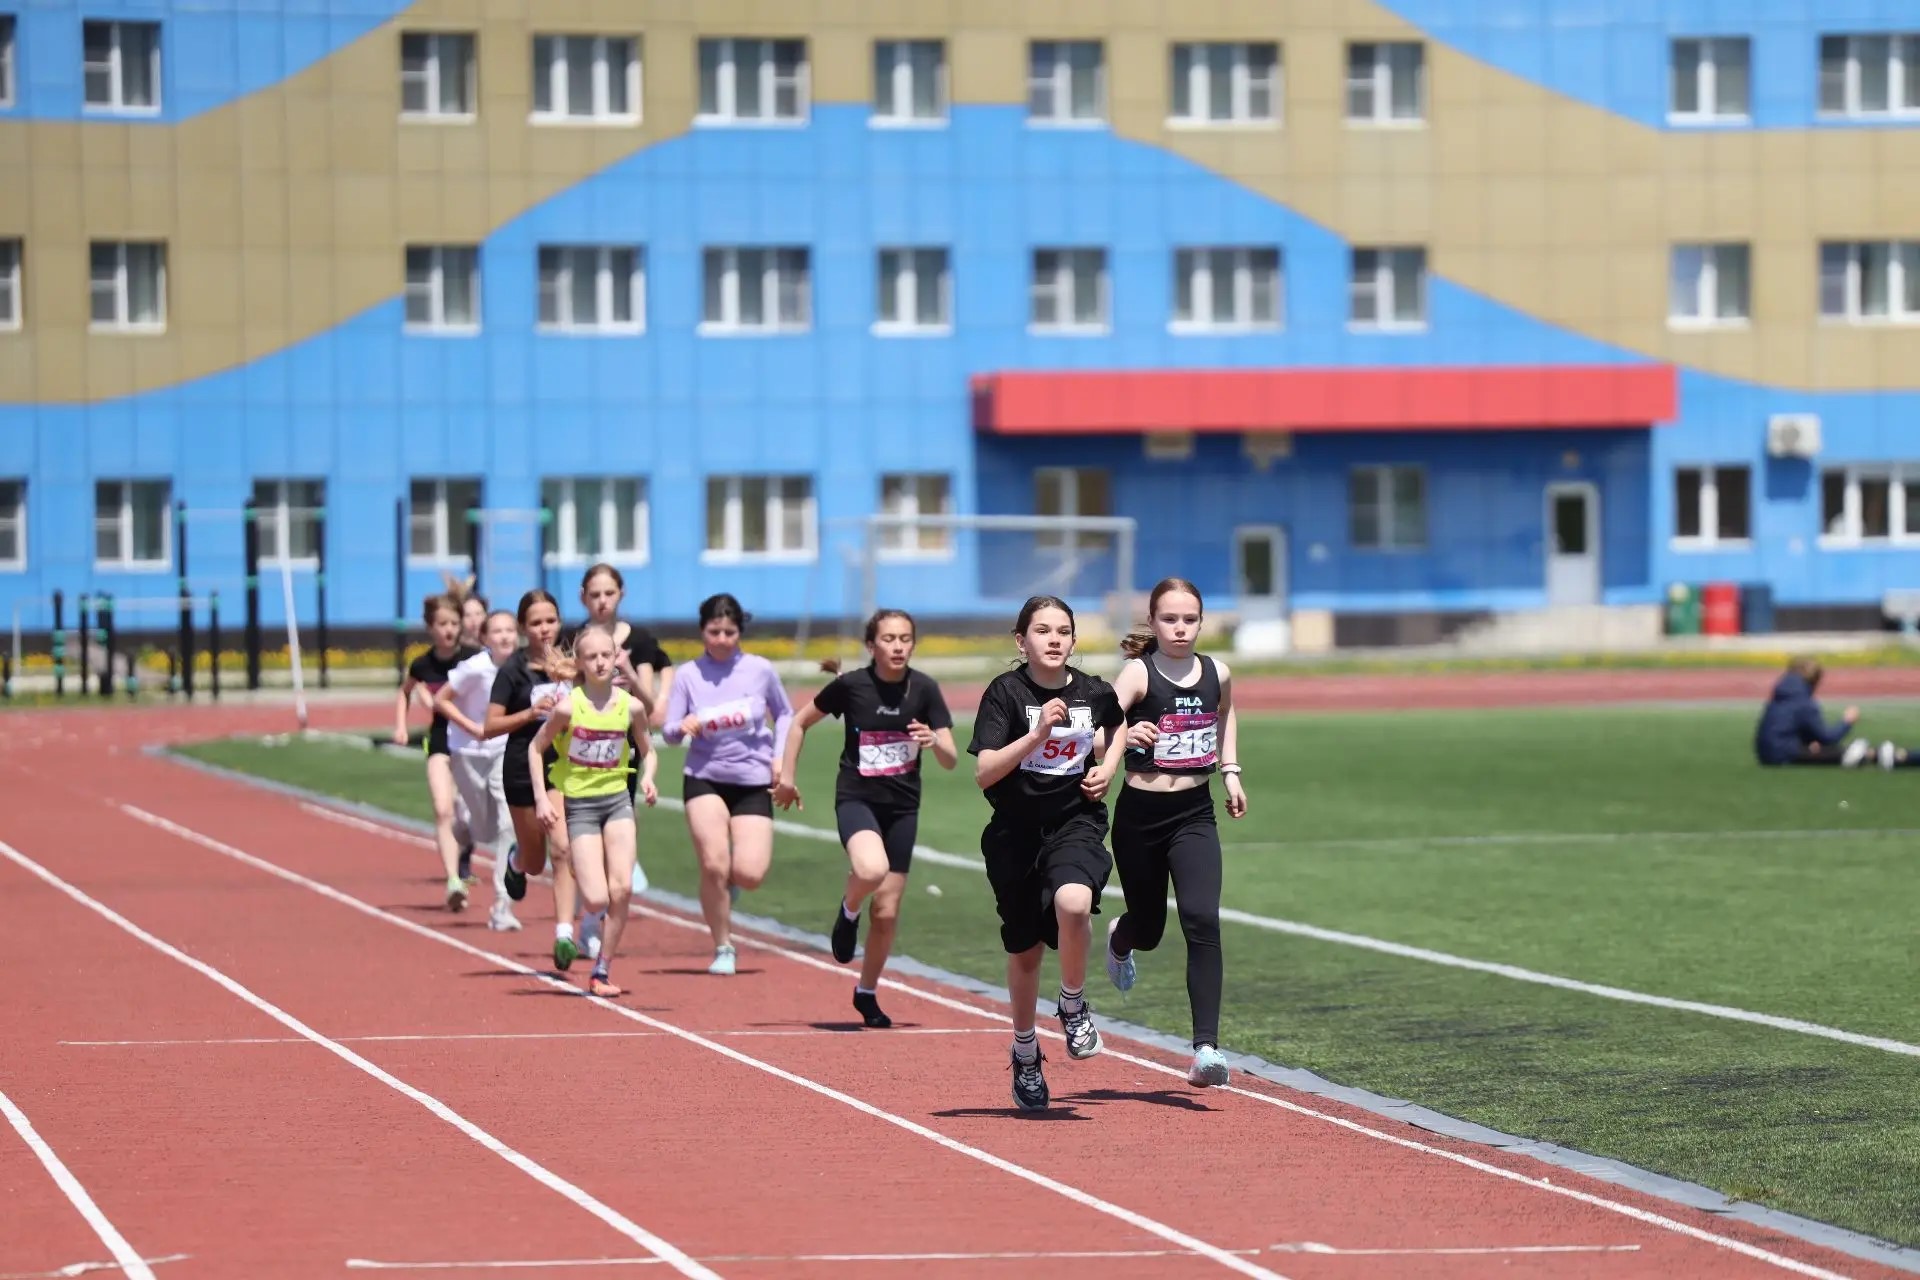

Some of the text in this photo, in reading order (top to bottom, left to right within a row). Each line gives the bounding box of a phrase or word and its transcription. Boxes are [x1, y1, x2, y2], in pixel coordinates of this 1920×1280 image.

[1175, 696, 1203, 707] FILA
[578, 741, 616, 760] 218
[1042, 739, 1077, 760] 54
[1167, 732, 1212, 755] 215
